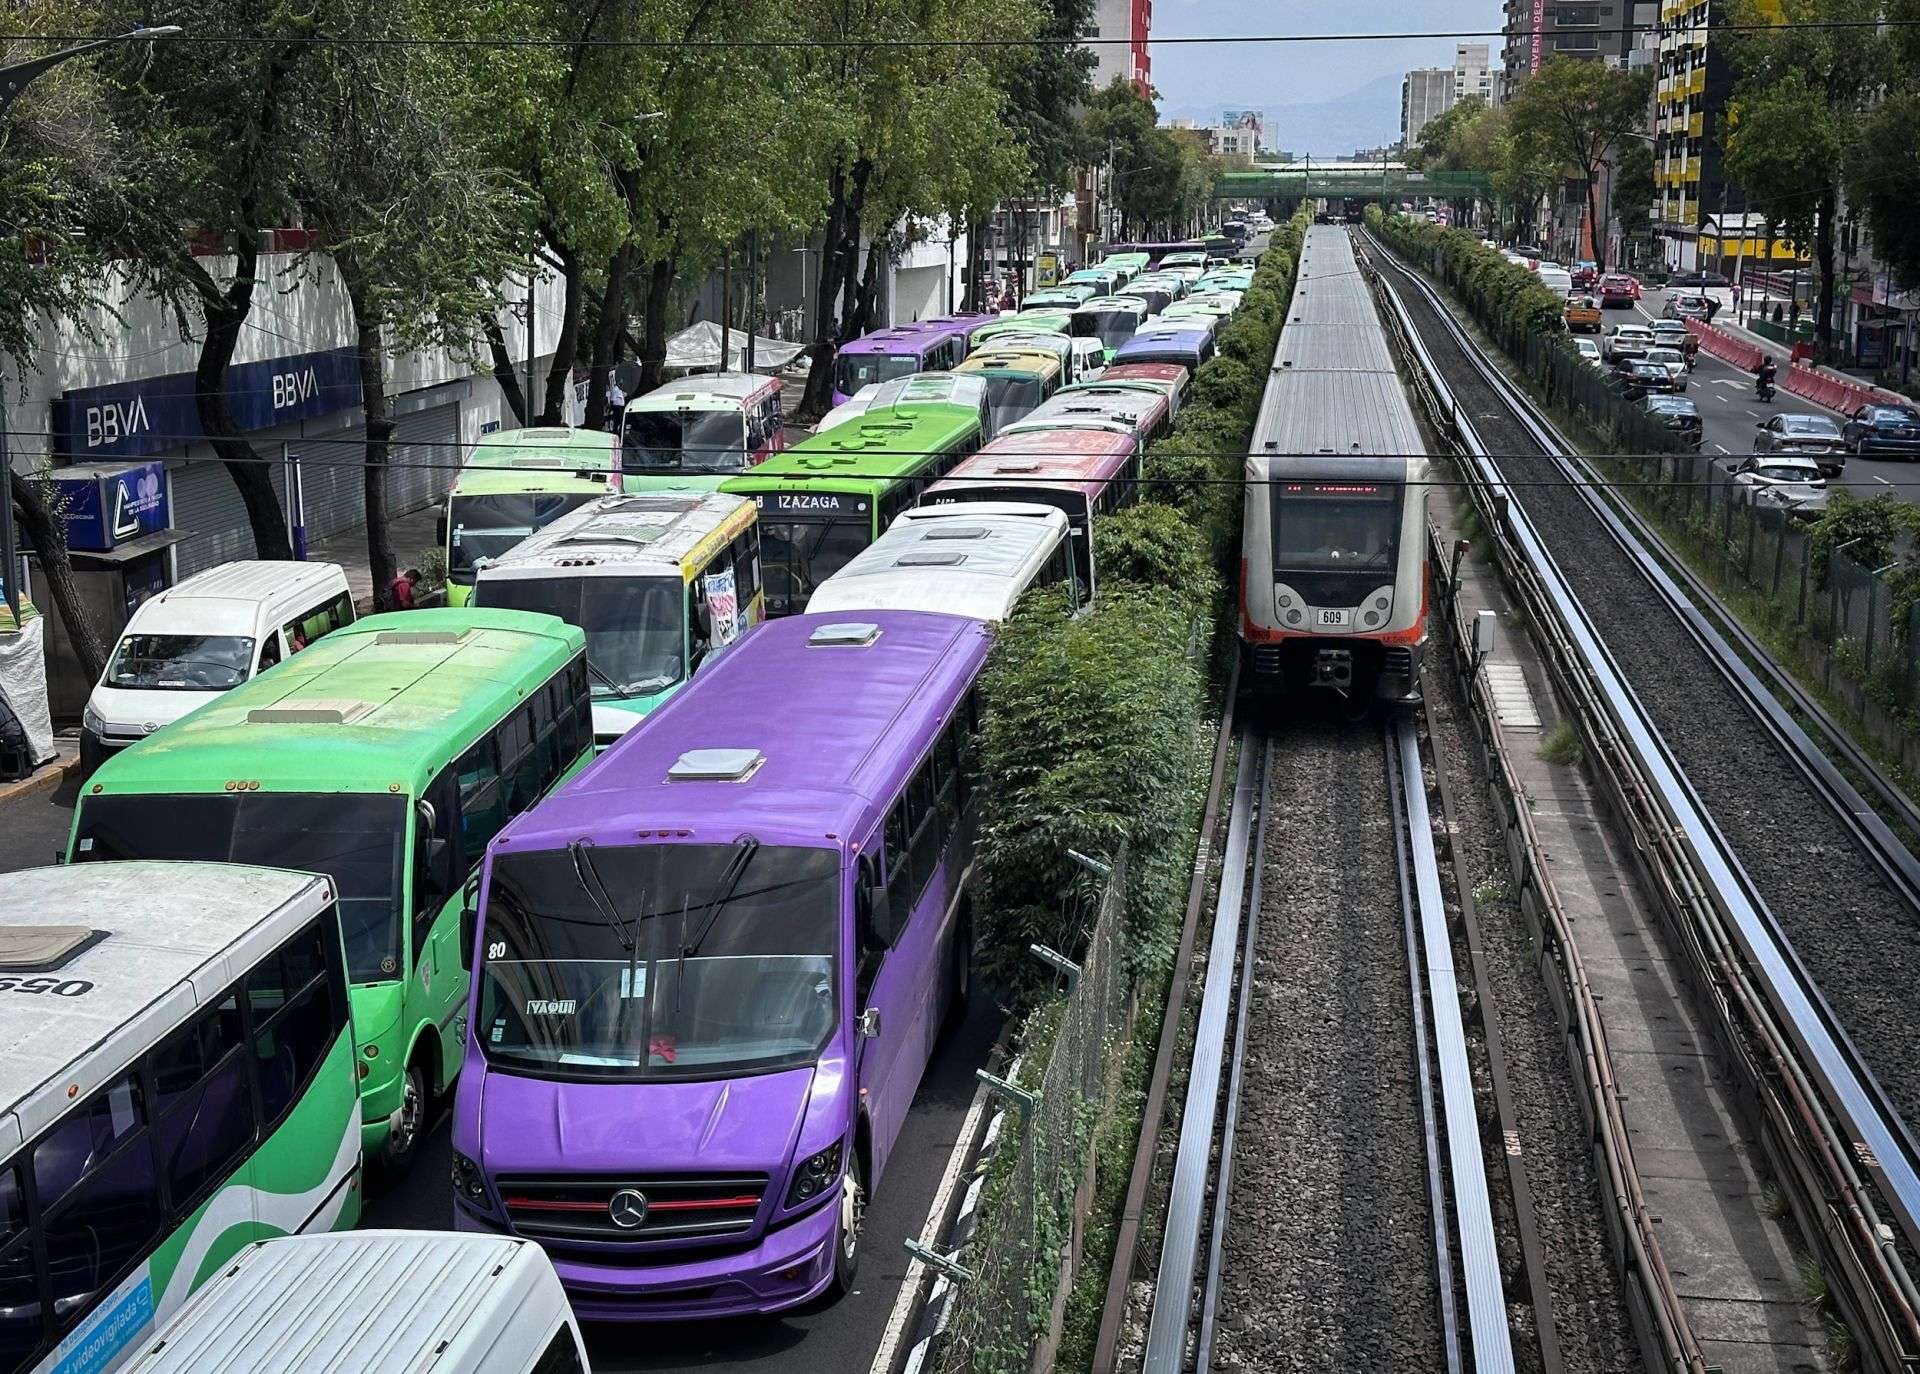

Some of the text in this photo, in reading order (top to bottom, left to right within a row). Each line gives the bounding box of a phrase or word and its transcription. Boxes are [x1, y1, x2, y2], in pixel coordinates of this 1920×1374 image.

[1531, 26, 1540, 76] REVENTA
[273, 365, 319, 409] BBVA
[86, 394, 149, 447] BBVA
[778, 495, 840, 509] IZAZAGA
[1323, 611, 1342, 624] 609
[489, 942, 506, 960] 80
[72, 1300, 138, 1374] videovigilada
